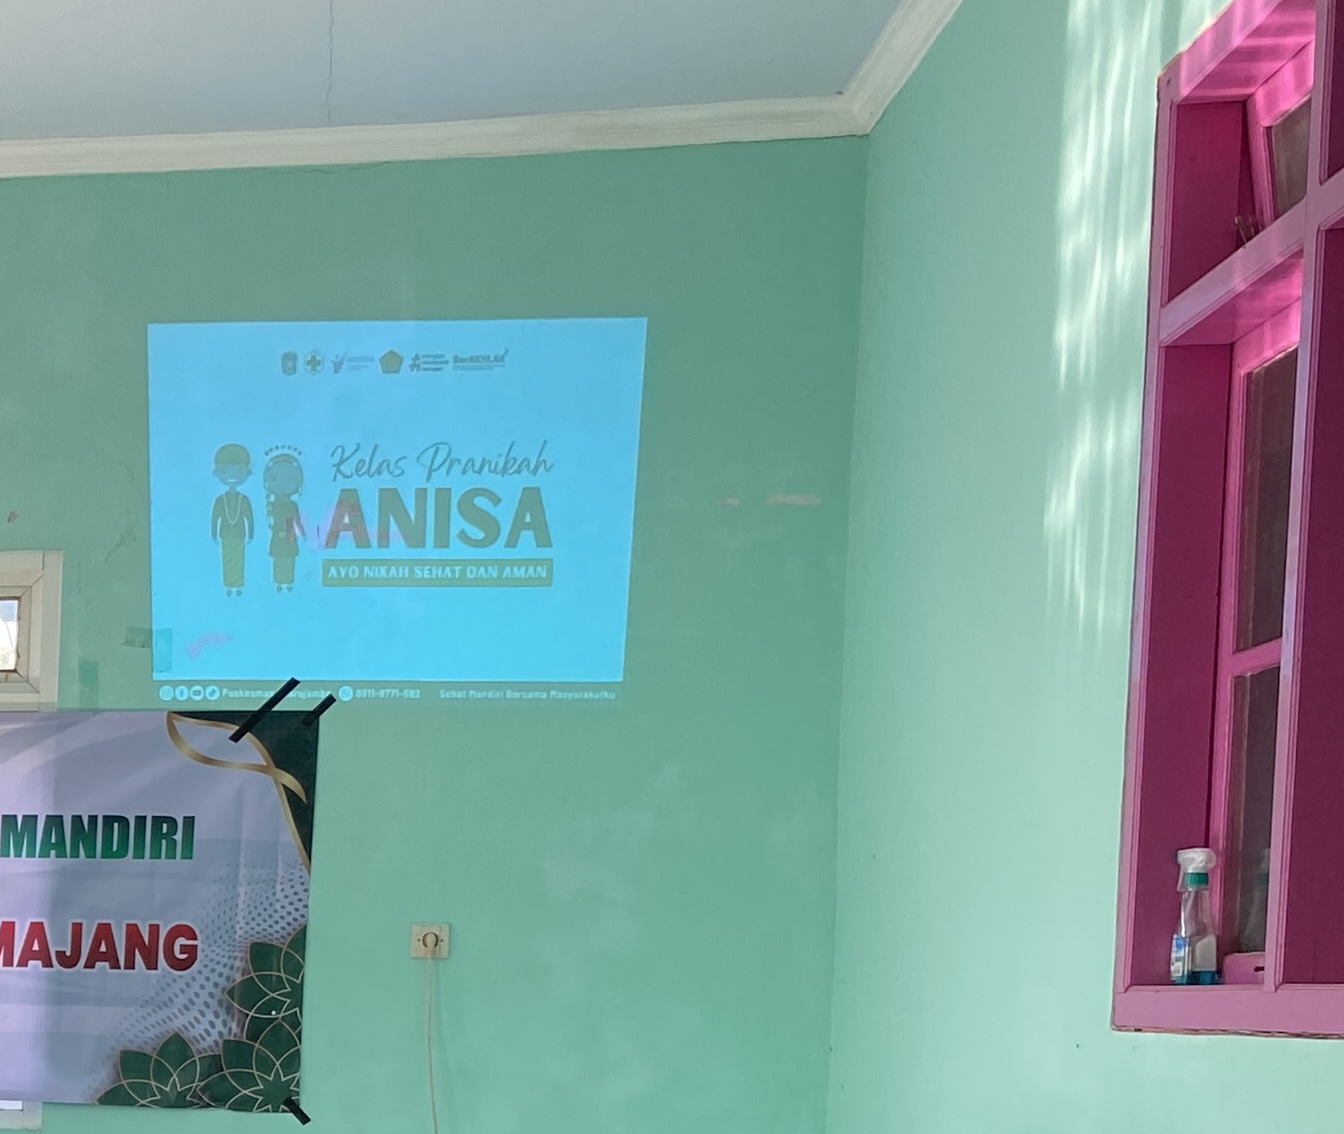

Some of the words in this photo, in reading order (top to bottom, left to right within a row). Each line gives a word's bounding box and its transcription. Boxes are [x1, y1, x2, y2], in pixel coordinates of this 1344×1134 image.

[330, 442, 408, 482] Kelas
[416, 440, 554, 483] Pranikah
[323, 486, 554, 549] ANISA
[327, 565, 360, 579] AYO
[363, 565, 410, 579] NIKAH
[413, 565, 463, 579] SEHAT
[466, 565, 498, 579] DAN
[502, 565, 548, 579] AMAN
[0, 813, 197, 861] MANDIRI
